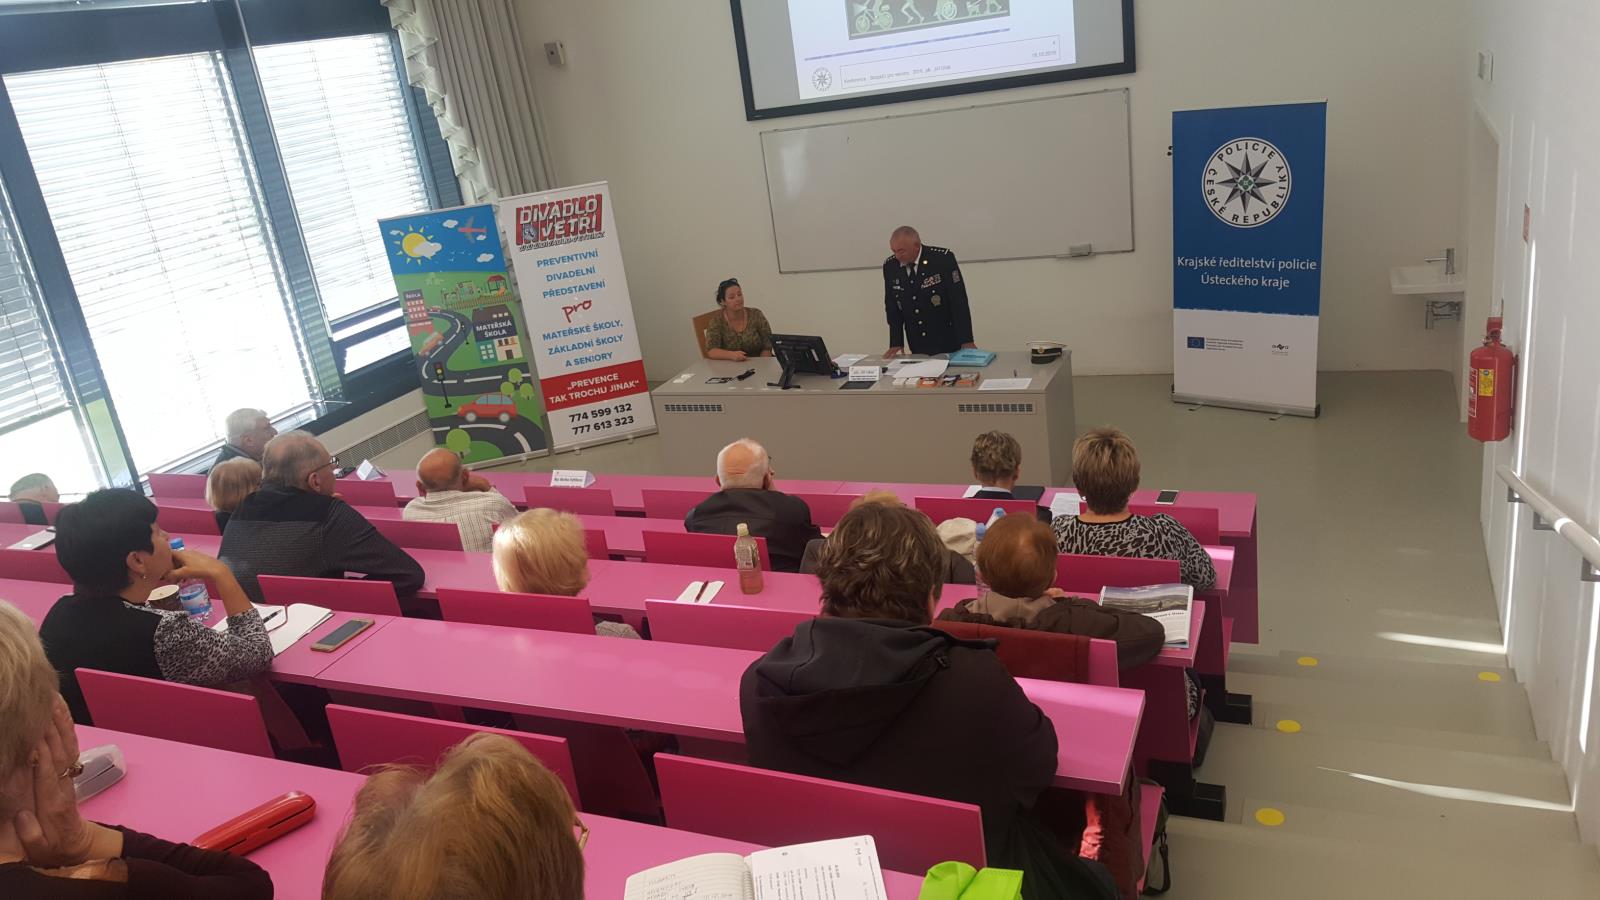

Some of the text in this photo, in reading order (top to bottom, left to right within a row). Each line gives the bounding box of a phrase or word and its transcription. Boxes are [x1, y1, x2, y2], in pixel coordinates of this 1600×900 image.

[1217, 141, 1276, 162] POLICIE
[1206, 165, 1287, 224] ČESKÉ REPUBLIKY
[520, 198, 598, 225] DIVADLO
[536, 248, 599, 268] PREVENTIVNÍ
[1177, 256, 1317, 271] Krajské ředitelství policie
[546, 265, 596, 282] DIVADELNÍ
[1200, 272, 1290, 290] Ústeckého kraje
[542, 279, 606, 299] PŘEDSTAVENÍ
[561, 299, 592, 324] pro
[484, 329, 508, 338] ŠKOLA
[548, 334, 624, 356] ZÁKLADNÍ ŠKOLY
[565, 352, 613, 367] A SENIORY
[548, 394, 567, 404] TAK
[568, 386, 608, 400] TROCHU
[569, 403, 633, 423] 774 599 132
[572, 415, 634, 435] 777 613 323
